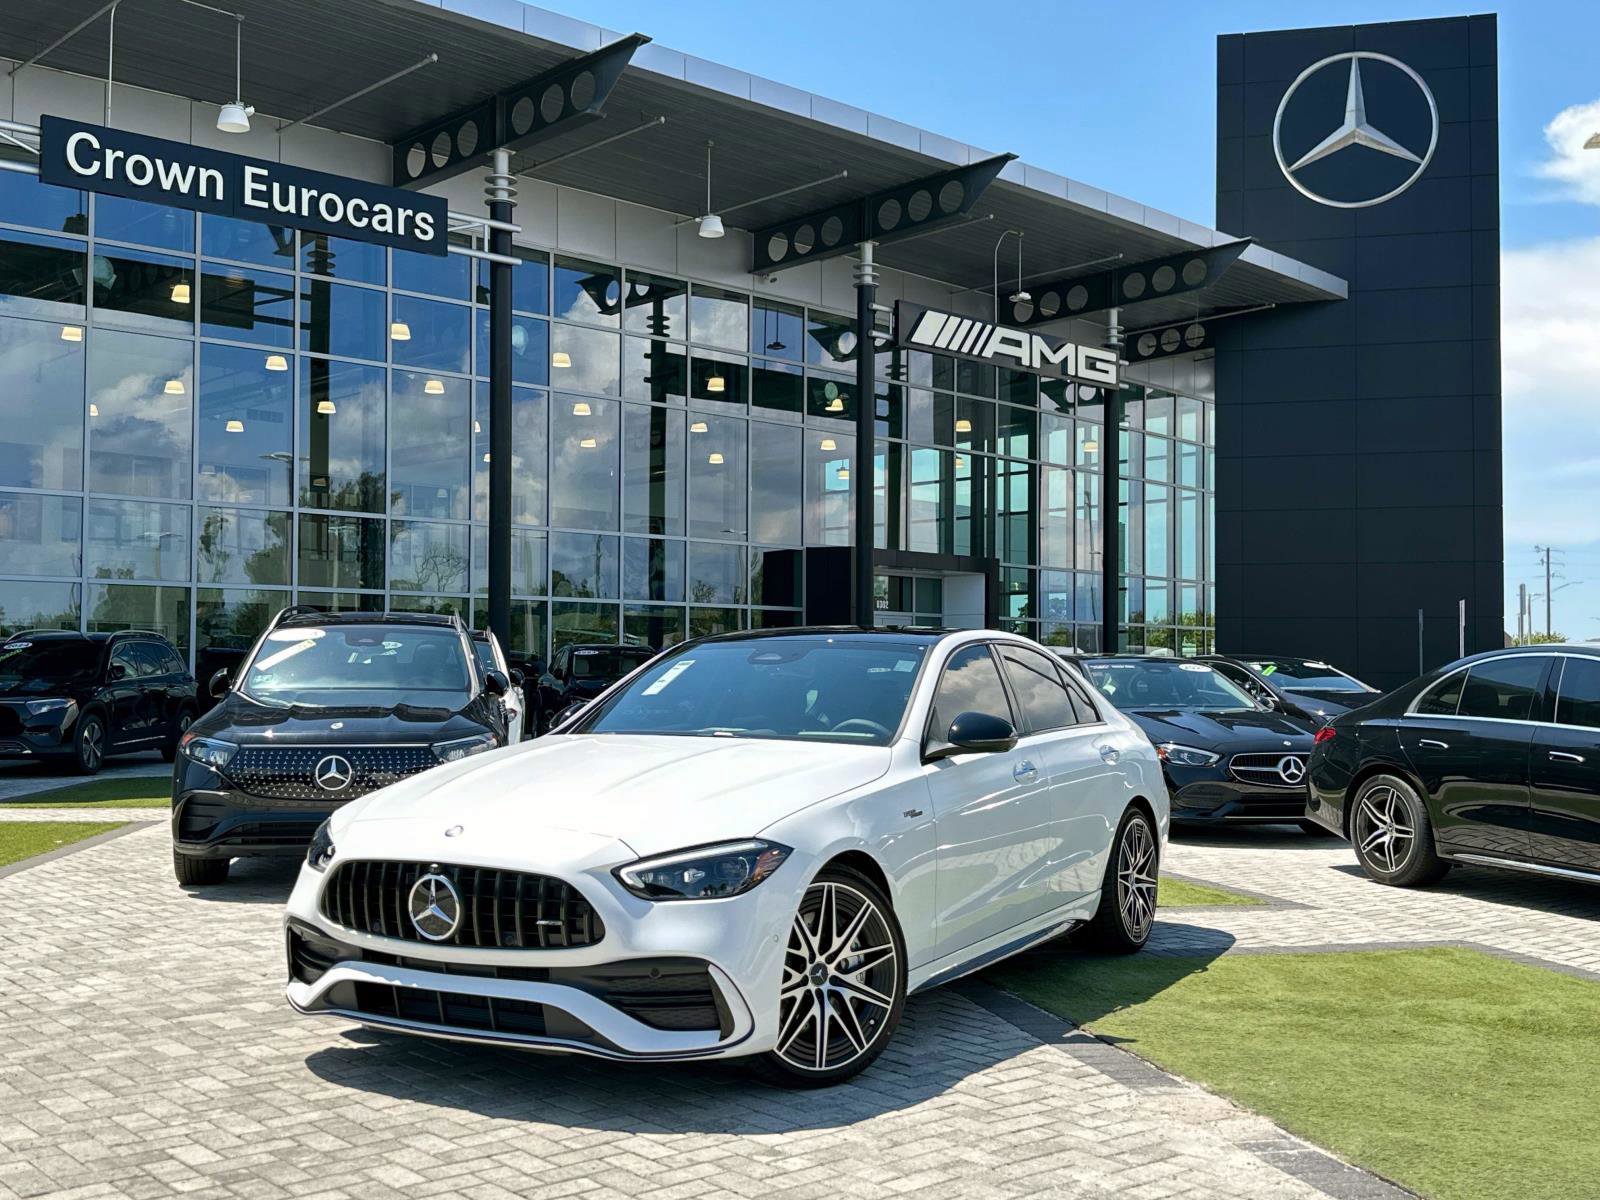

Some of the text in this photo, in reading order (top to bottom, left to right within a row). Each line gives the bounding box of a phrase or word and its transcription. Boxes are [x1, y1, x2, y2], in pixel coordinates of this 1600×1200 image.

[65, 131, 436, 241] Crown Eurocars
[981, 326, 1117, 384] AMG
